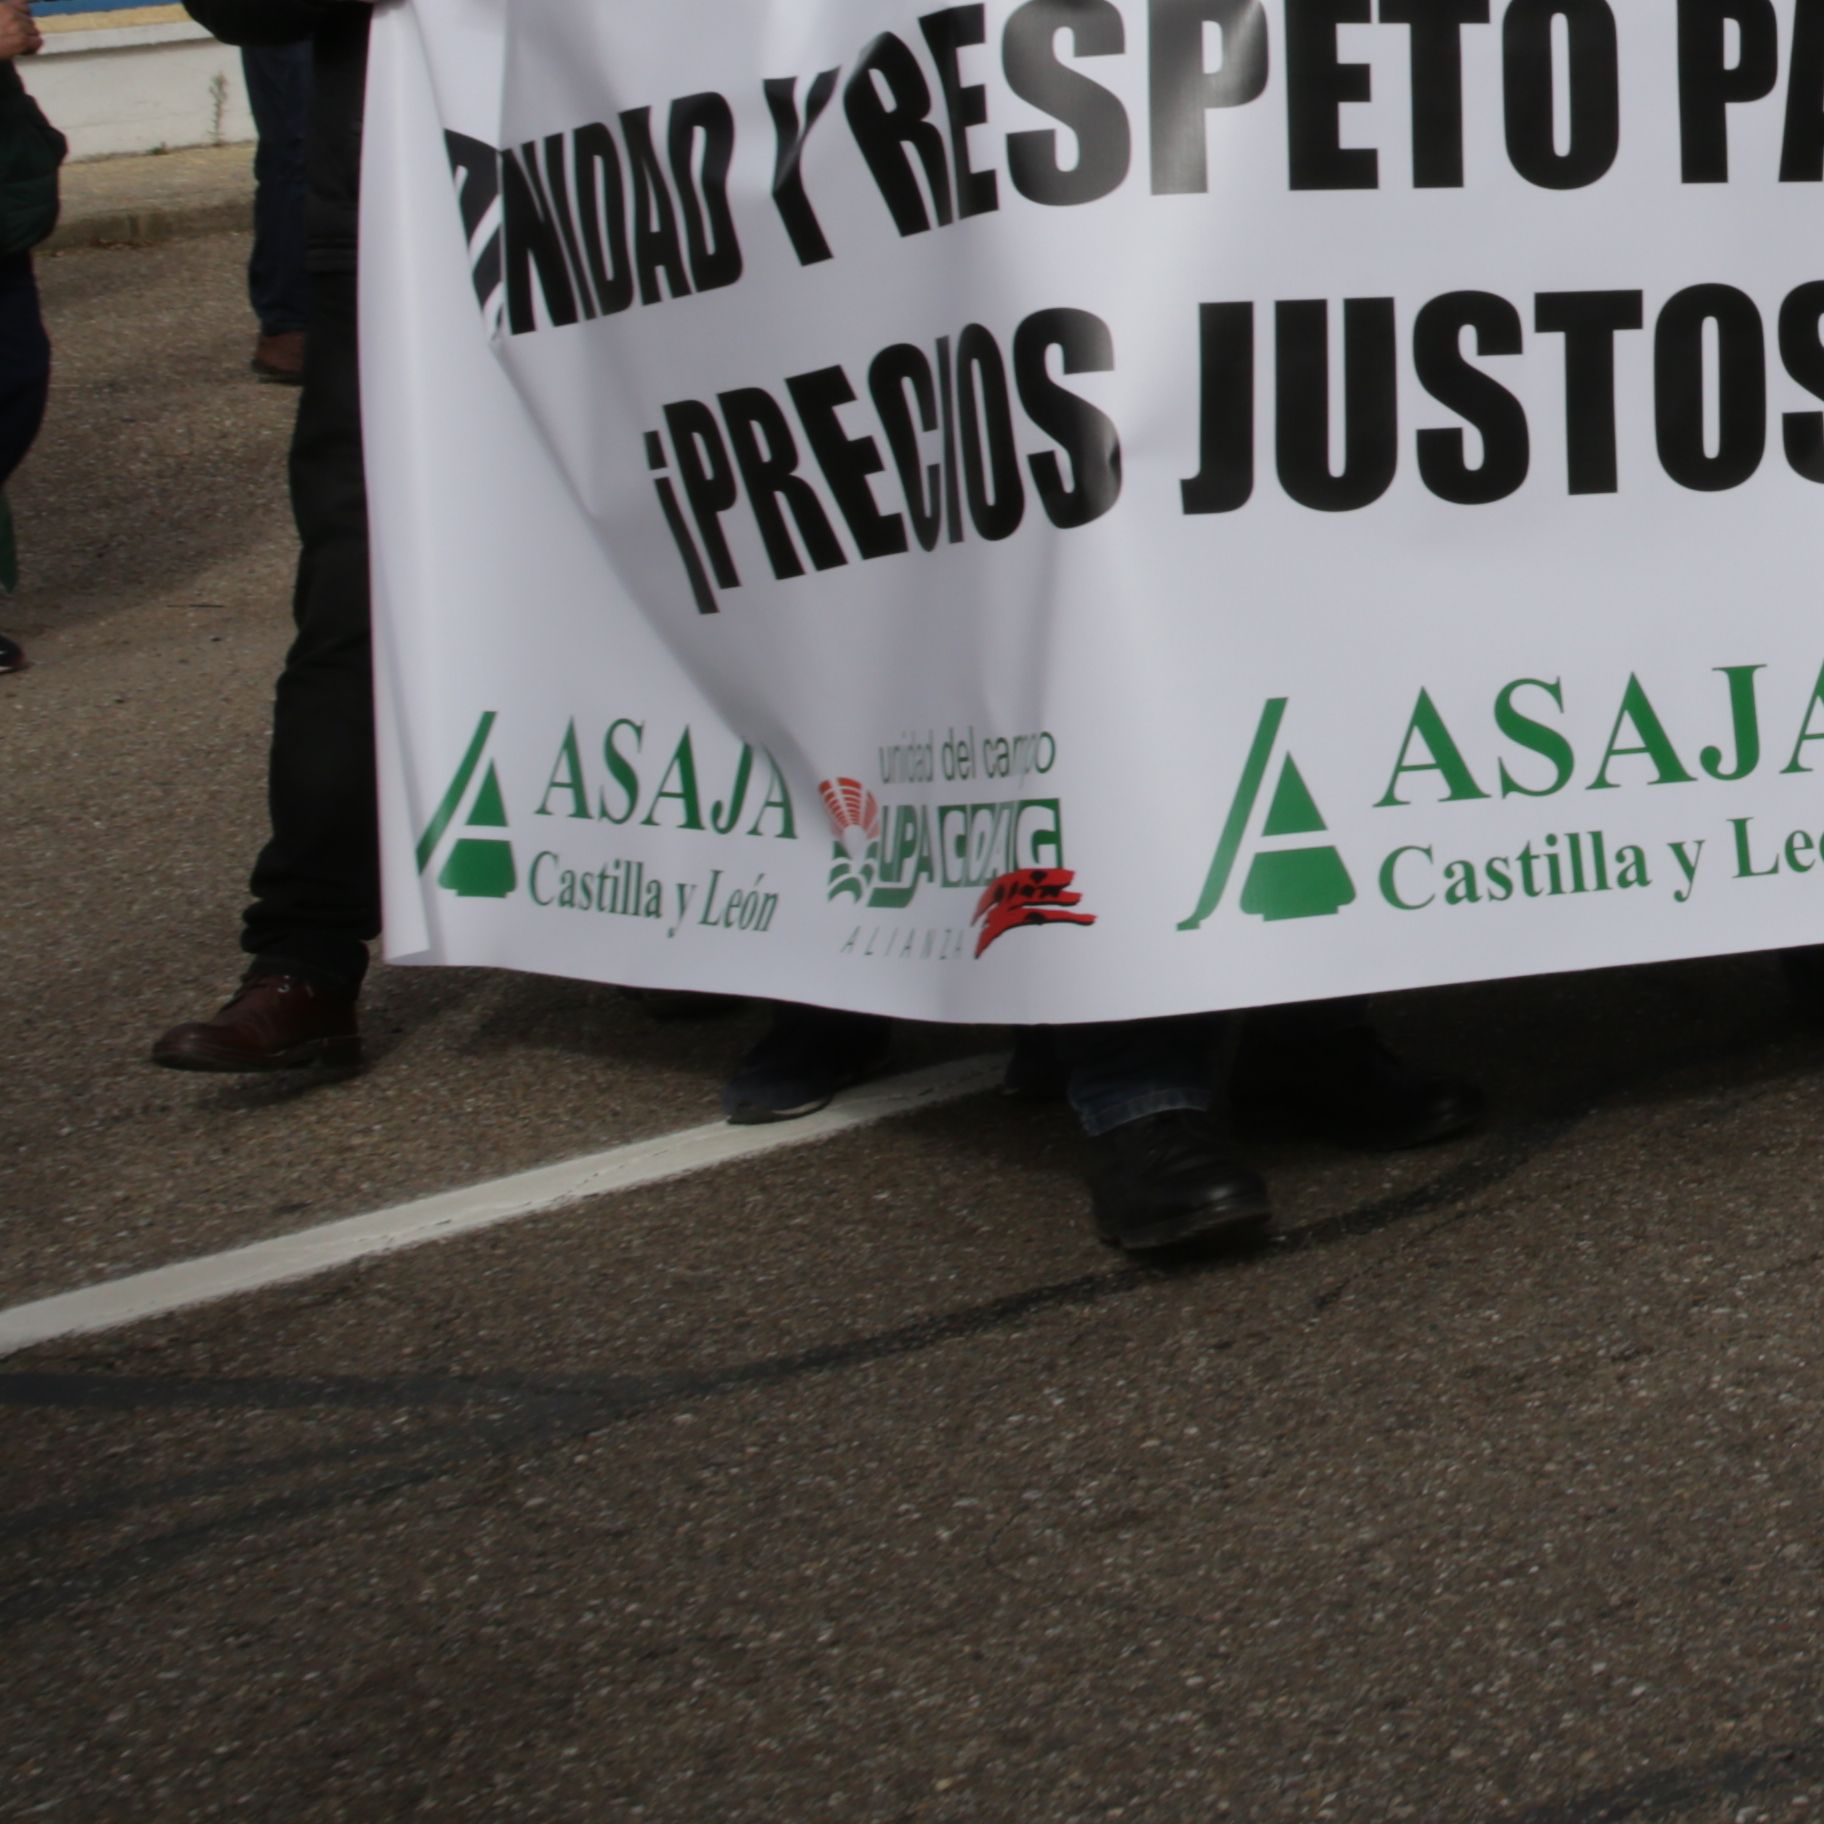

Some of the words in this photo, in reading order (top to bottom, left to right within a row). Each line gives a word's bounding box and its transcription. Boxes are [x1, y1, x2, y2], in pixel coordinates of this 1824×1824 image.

[763, 66, 841, 267] Y
[532, 714, 800, 841] ASAJA
[941, 726, 976, 781] del
[527, 850, 663, 919] Castilla
[666, 881, 697, 938] y
[700, 869, 780, 934] León
[866, 803, 935, 909] UPA
[1378, 829, 1651, 912] Castilla
[1666, 838, 1705, 903] y
